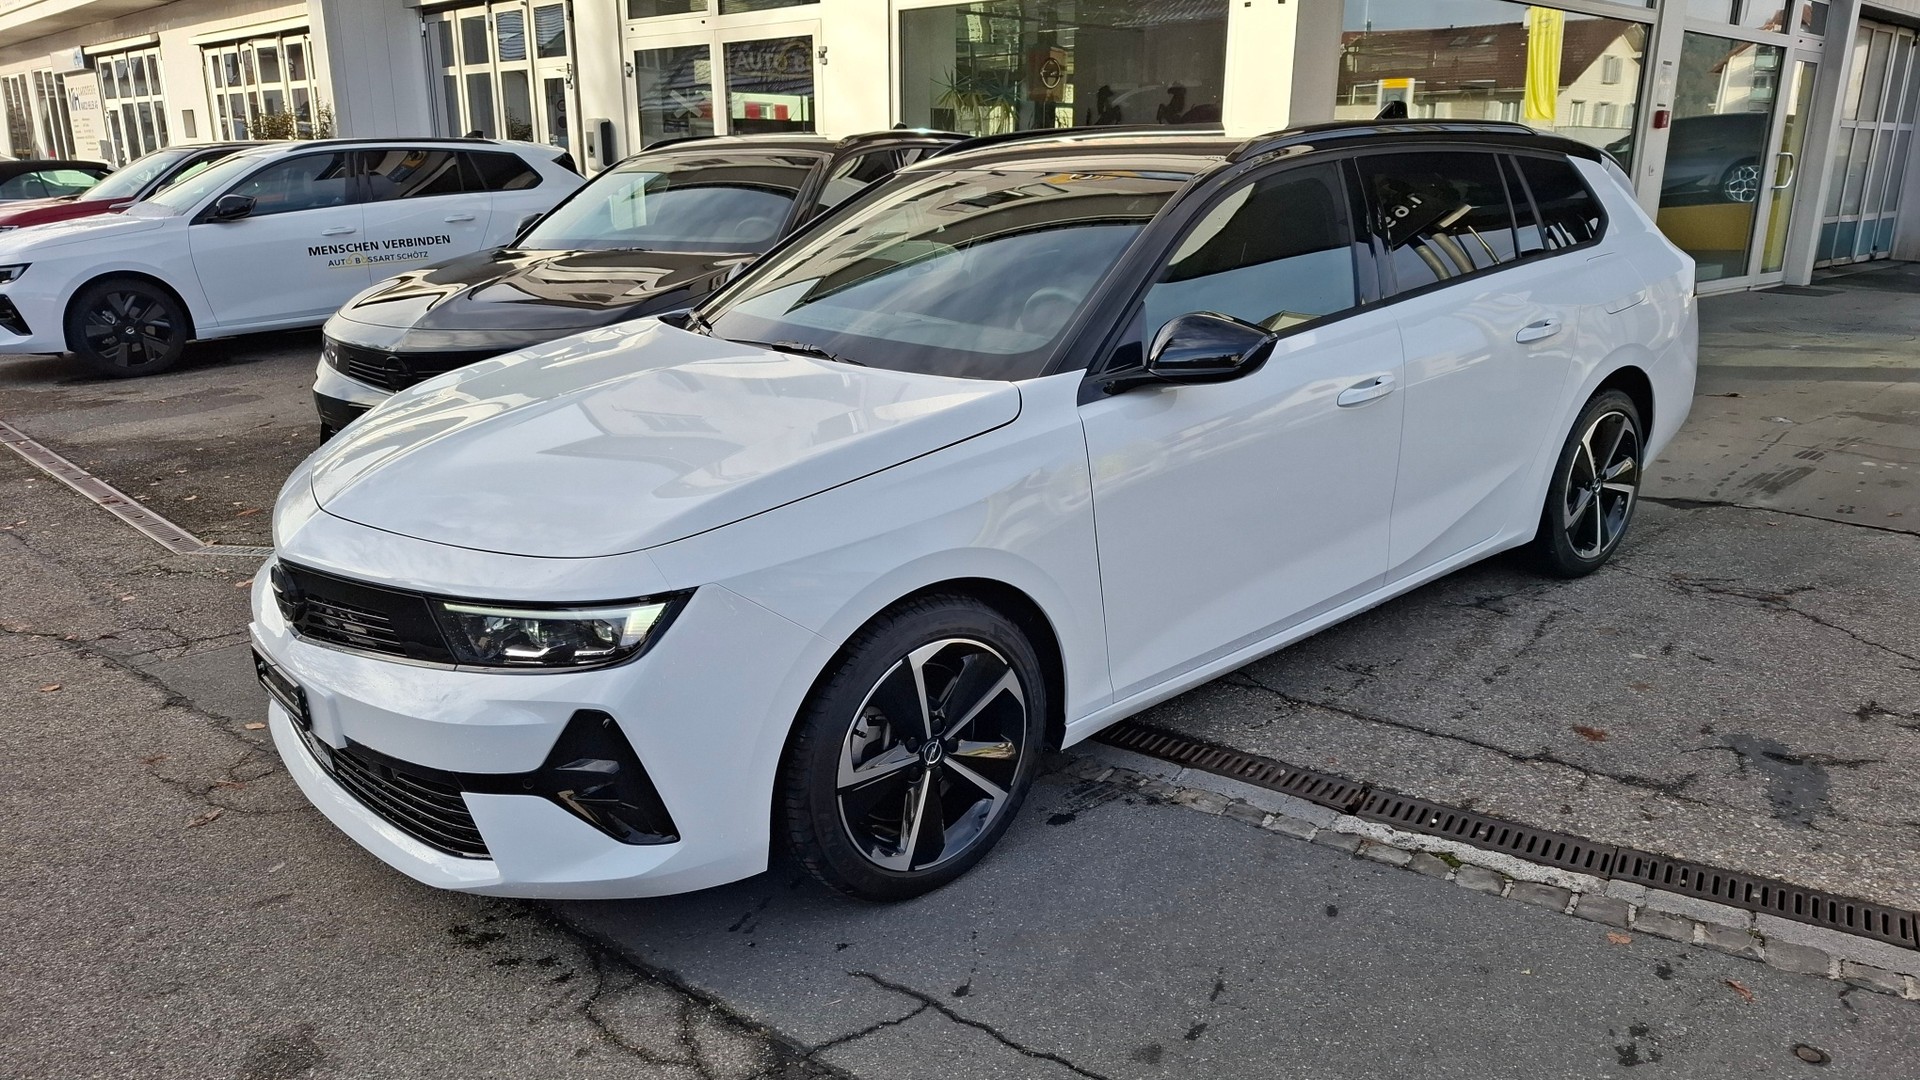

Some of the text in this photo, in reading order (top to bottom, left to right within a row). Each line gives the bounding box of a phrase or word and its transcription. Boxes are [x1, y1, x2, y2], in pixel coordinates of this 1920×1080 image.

[734, 51, 788, 71] AUTO
[308, 234, 451, 256] MENSCHEN VERBINDEN
[328, 251, 429, 267] AUTO BOSSART SCHÖTZ
